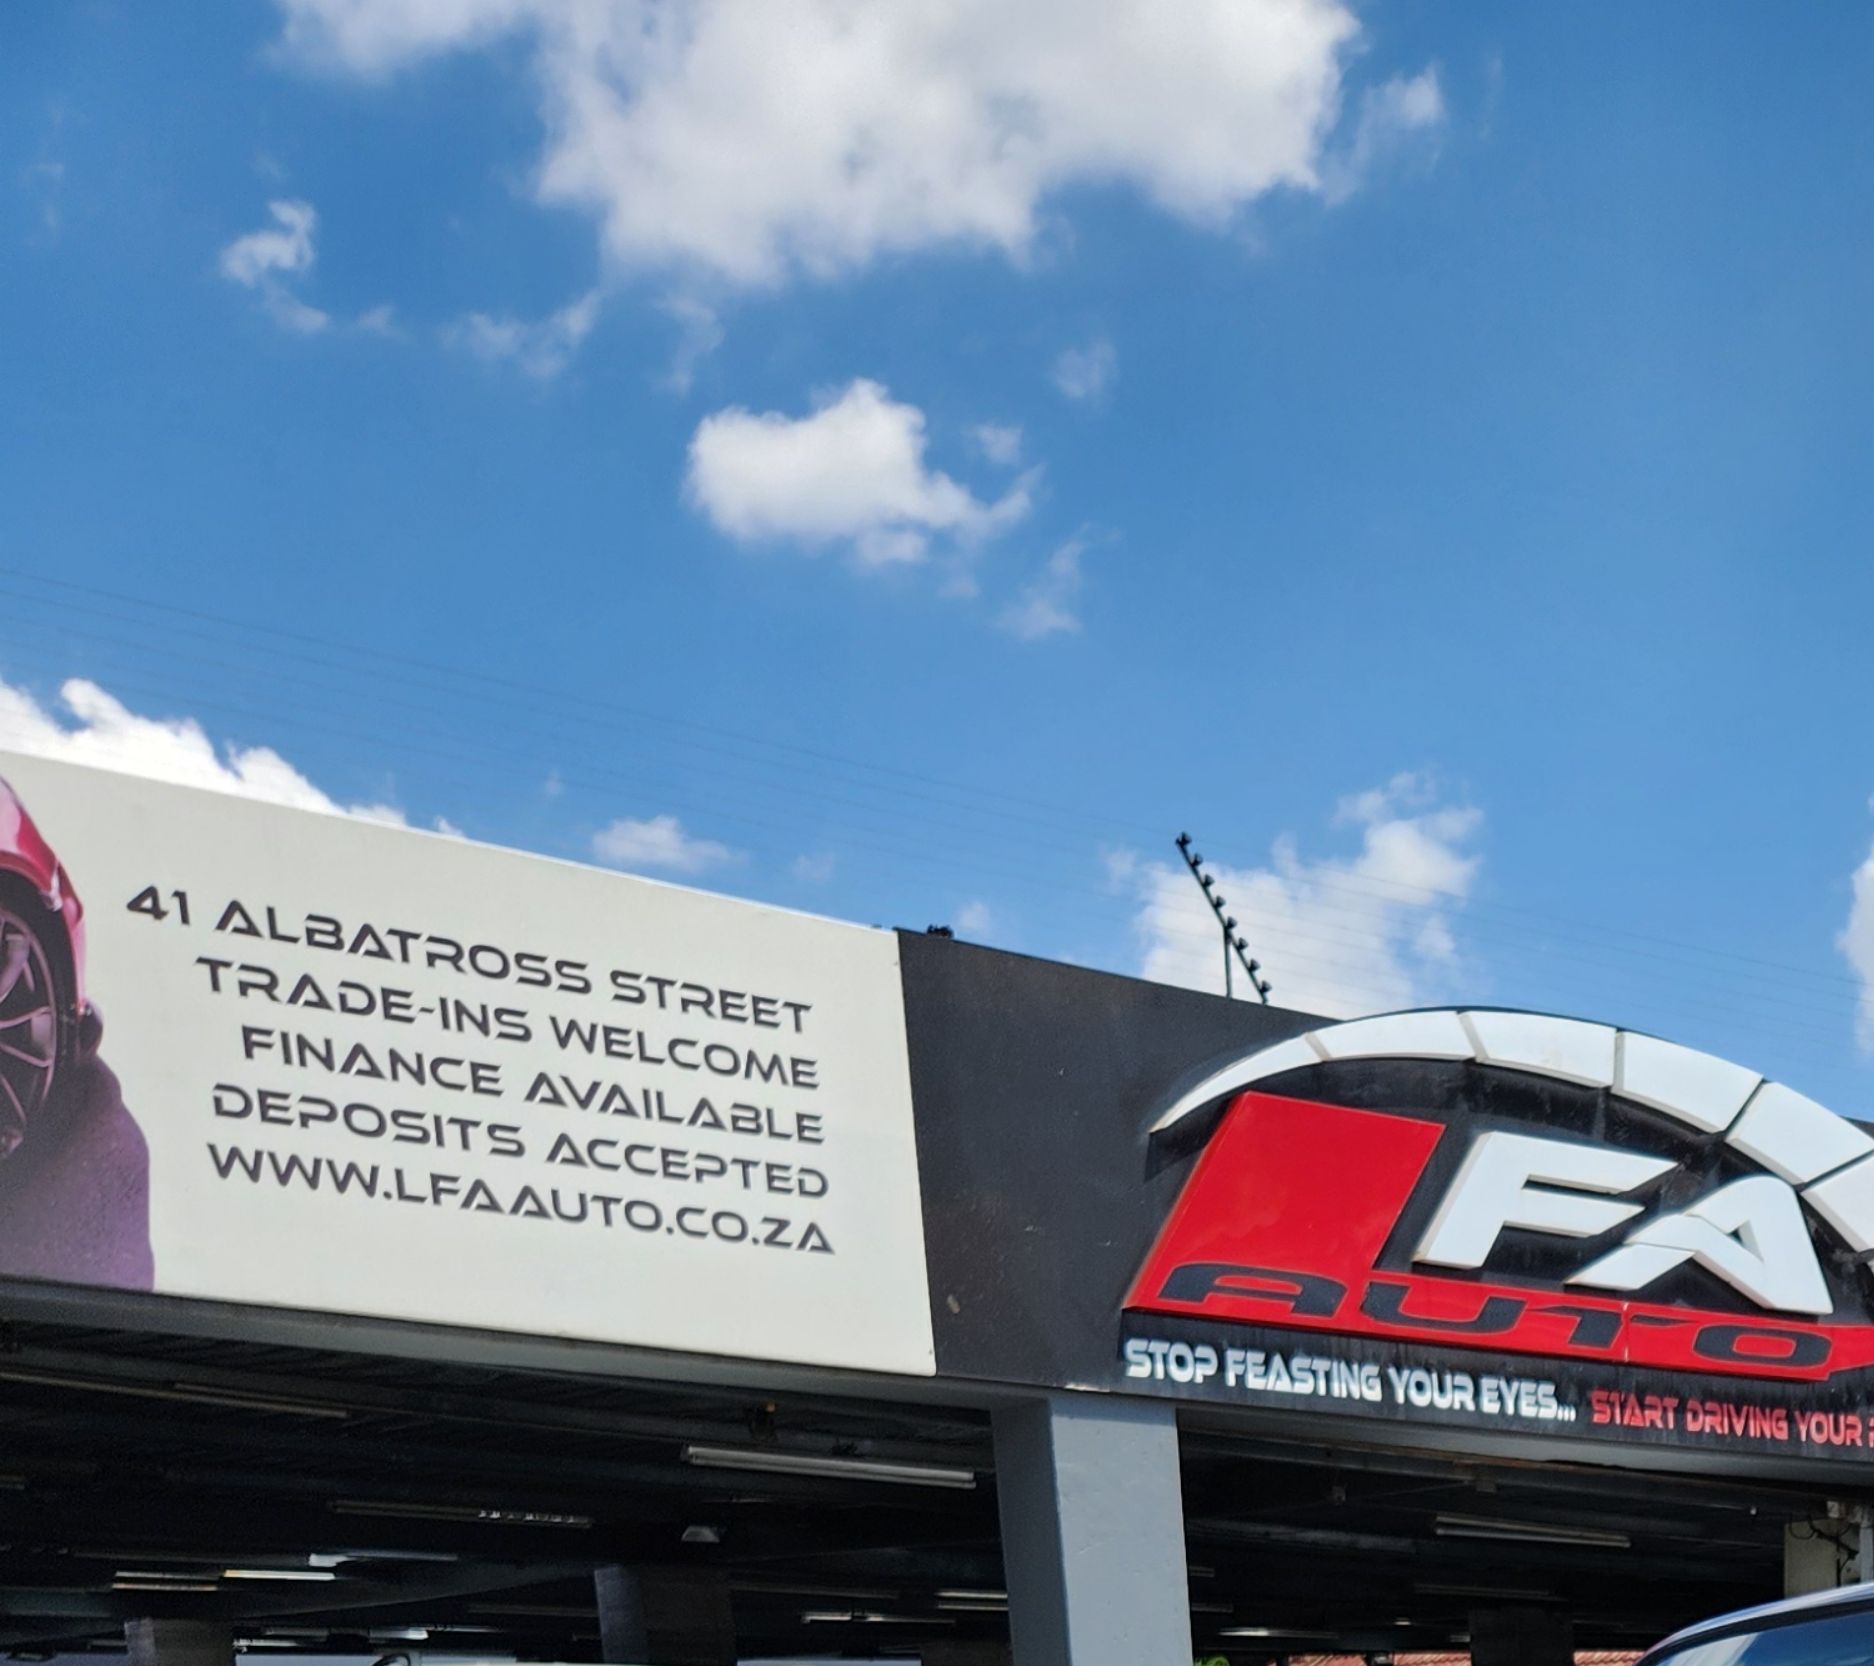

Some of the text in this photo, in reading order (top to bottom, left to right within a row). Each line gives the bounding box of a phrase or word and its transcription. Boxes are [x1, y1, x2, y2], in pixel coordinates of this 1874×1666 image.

[126, 884, 813, 1034] 41 ALBATROSS STREET
[194, 955, 820, 1091] TRADE-INS WELCOME
[211, 1081, 830, 1199] DEPOSITS ACCEPTED
[241, 1024, 826, 1145] FINANCE AVAILABLE
[206, 1141, 836, 1256] WWW.LFAAUTO.CO.ZA
[1156, 1261, 1832, 1369] AUTO
[1123, 1337, 1218, 1384] STOP
[1224, 1347, 1384, 1402] FEASTING
[1385, 1363, 1476, 1412] YOUR
[1478, 1375, 1577, 1423] EYES...
[1589, 1388, 1679, 1431] START
[1685, 1399, 1790, 1441] DRIVING
[1793, 1409, 1864, 1447] YOUR
